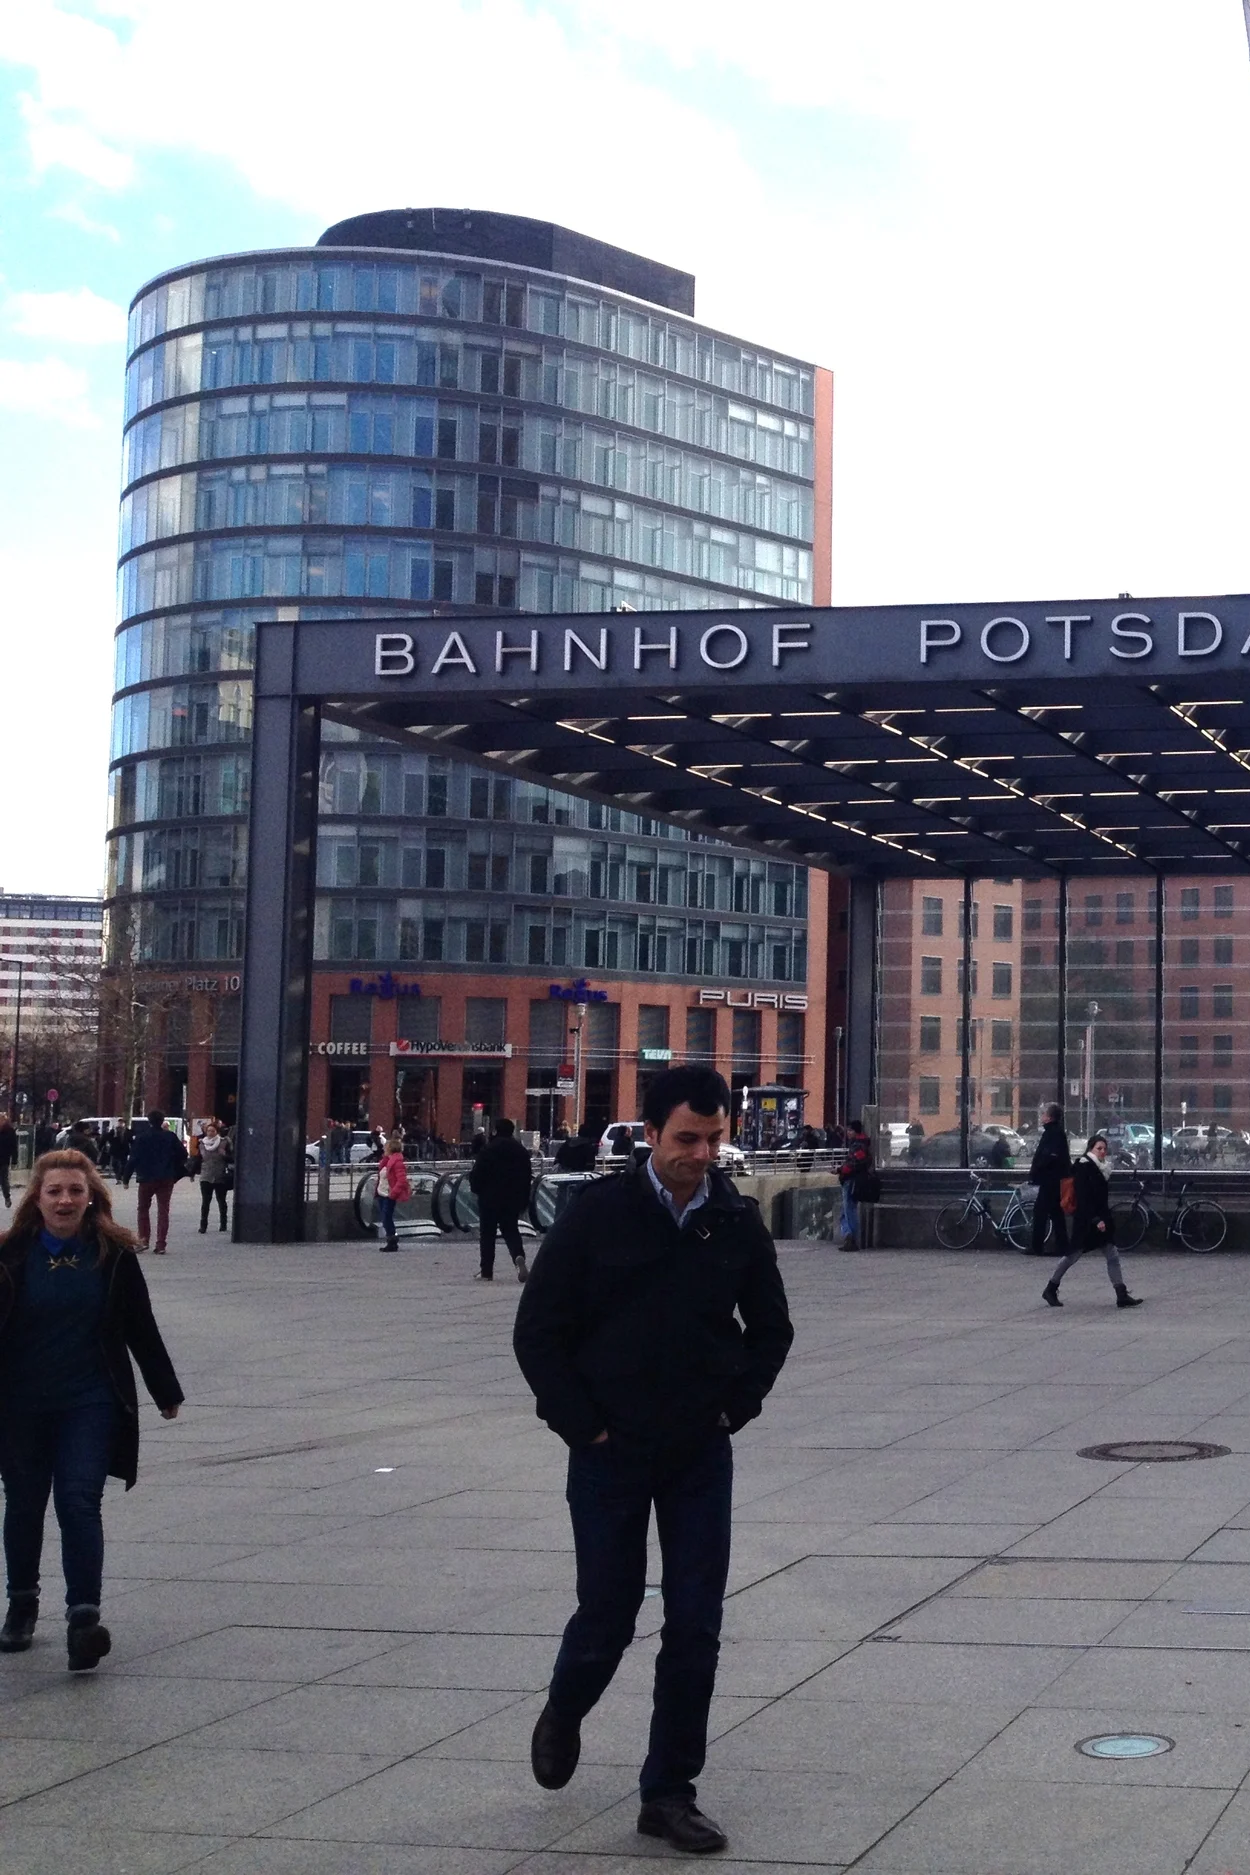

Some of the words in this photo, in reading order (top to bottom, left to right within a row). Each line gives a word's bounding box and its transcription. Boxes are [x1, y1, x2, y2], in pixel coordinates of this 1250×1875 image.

[374, 623, 811, 676] BAHNHOF
[184, 976, 218, 991] Platz
[224, 975, 240, 991] 10
[699, 989, 809, 1010] PURIS
[317, 1041, 368, 1055] COFFEE
[410, 1039, 507, 1053] HypoVesbank
